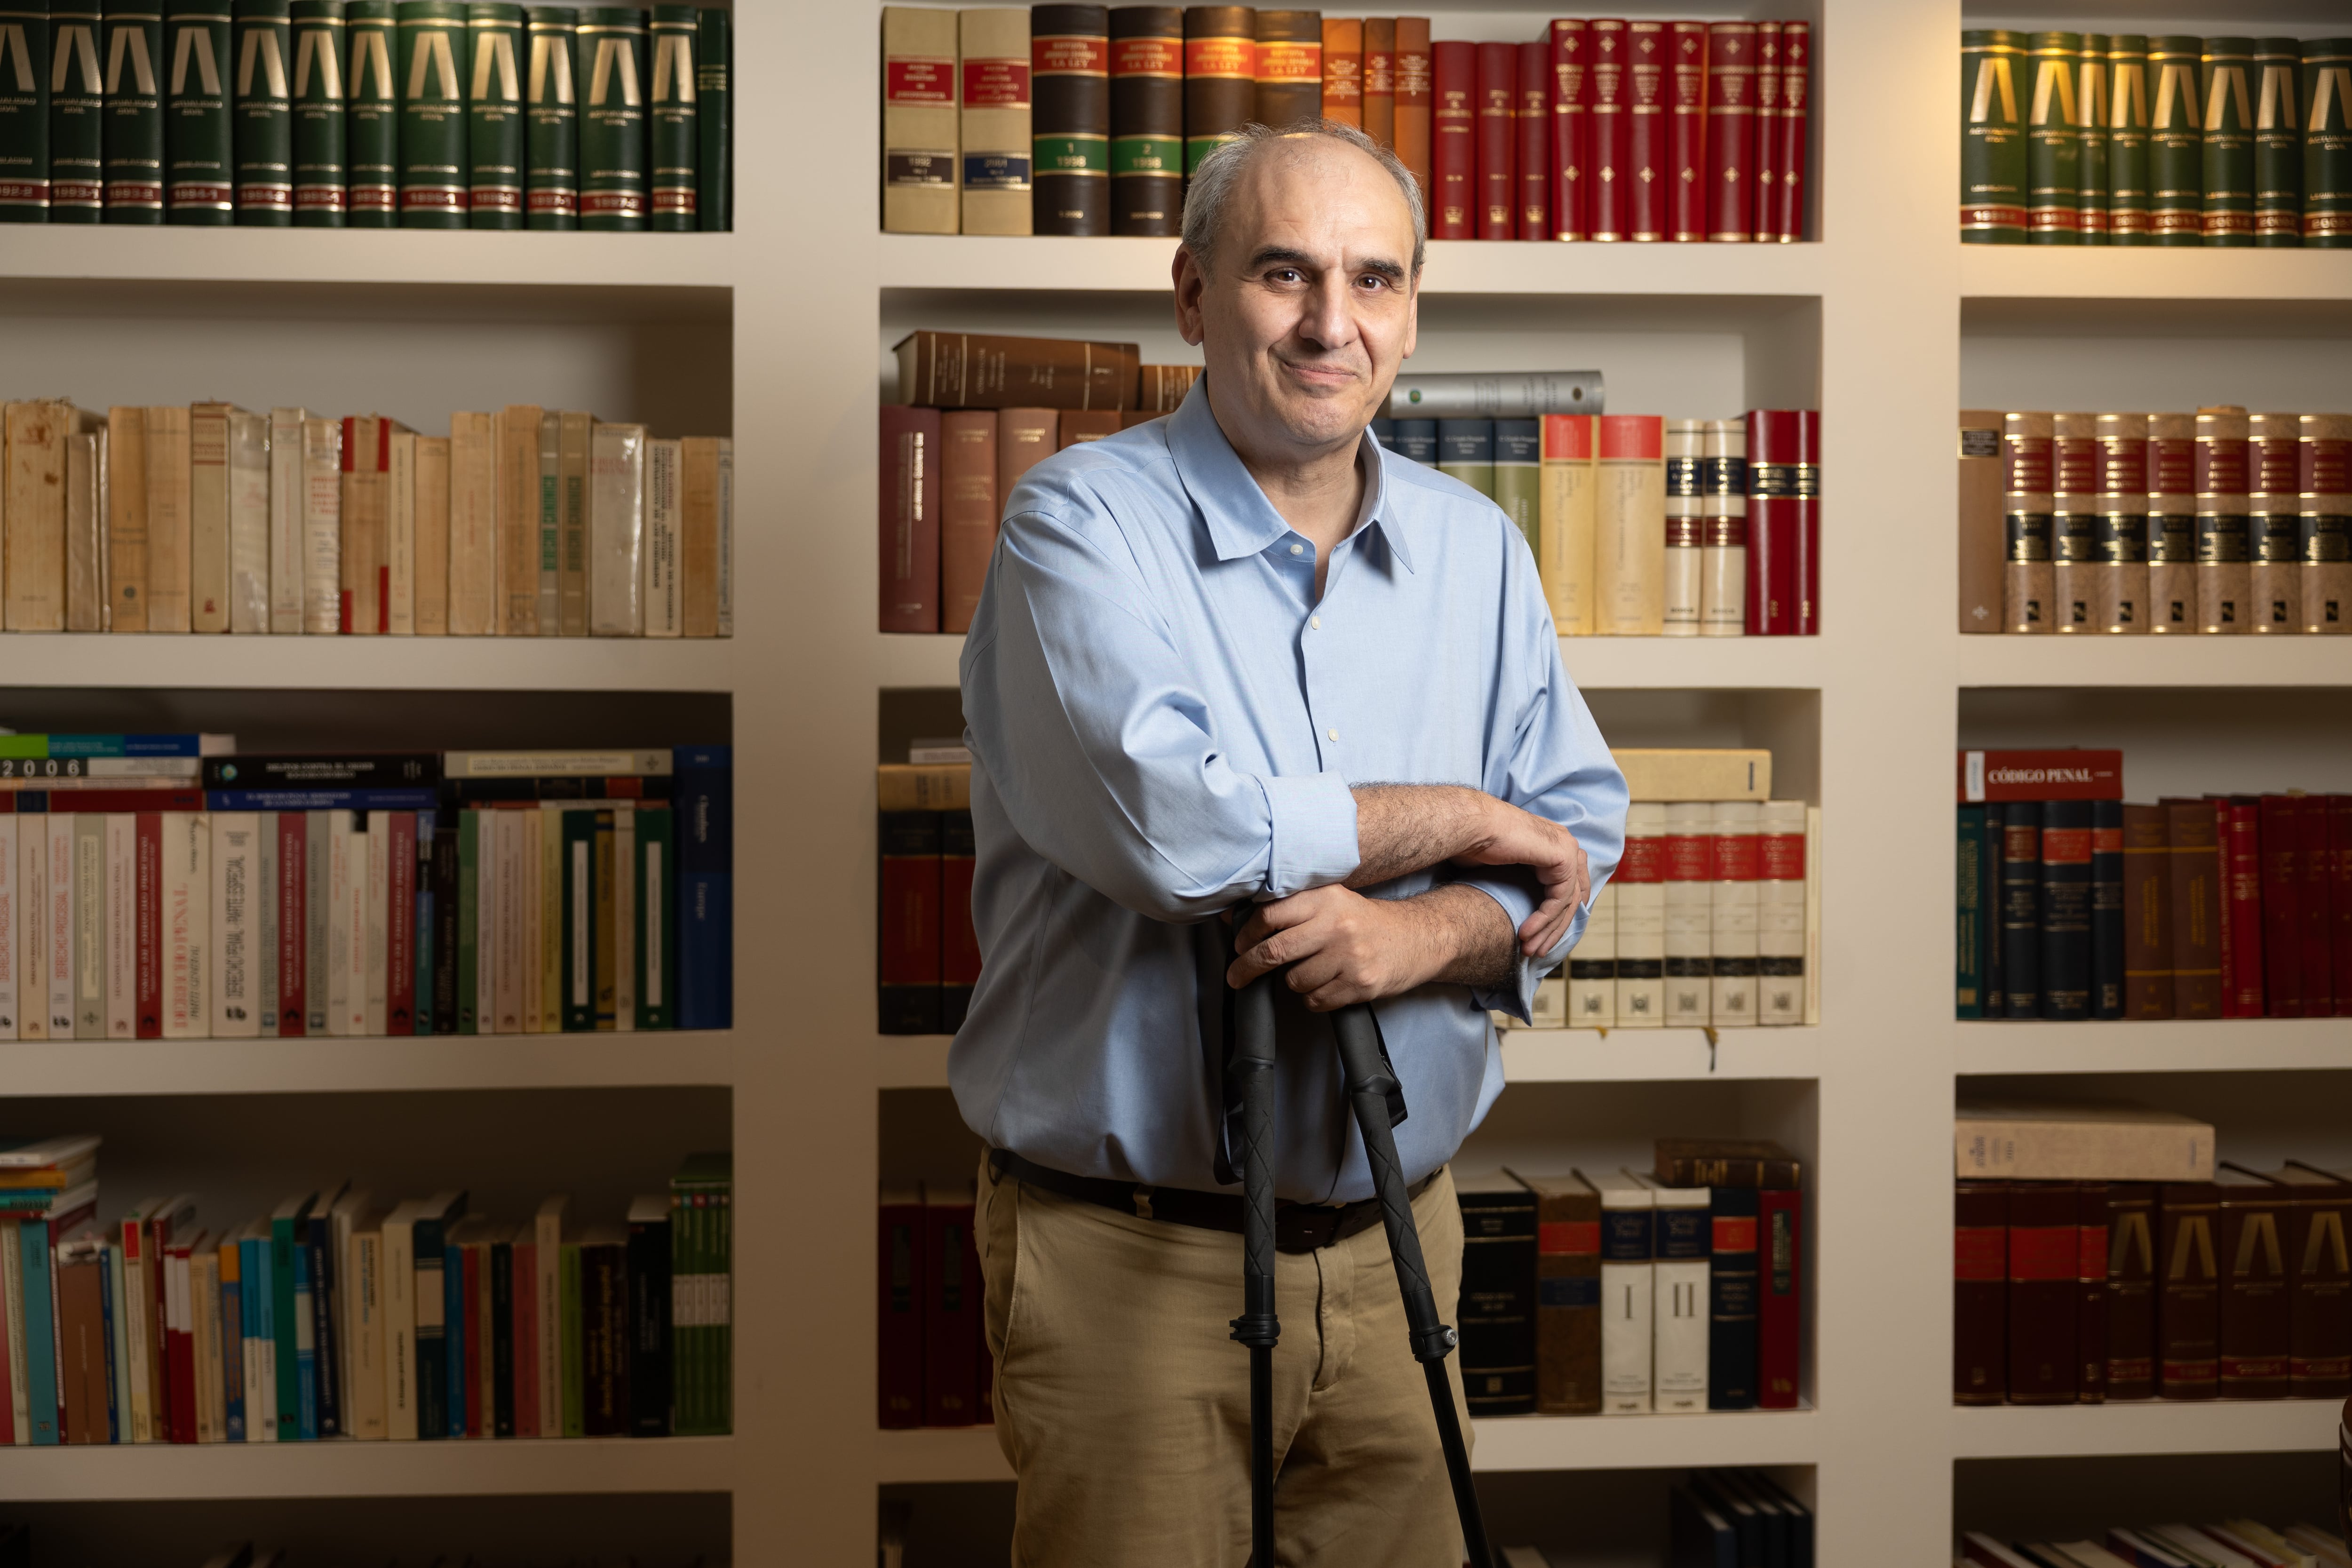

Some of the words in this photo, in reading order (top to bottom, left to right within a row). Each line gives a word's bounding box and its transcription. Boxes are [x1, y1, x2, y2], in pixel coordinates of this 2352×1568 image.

[1069, 59, 1089, 68] LEY
[1143, 144, 1152, 155] 2
[1057, 156, 1086, 167] 1998
[1133, 157, 1161, 168] 1998
[2312, 217, 2352, 230] 2002-
[2, 759, 79, 777] 2006
[1987, 766, 2045, 784] CÓDIGO
[2047, 768, 2093, 783] PENAL
[173, 882, 188, 942] PENAL
[173, 943, 188, 1027] DERECHO
[225, 956, 245, 999] DERECHO
[1622, 1284, 1635, 1319] I
[1671, 1282, 1696, 1317] II
